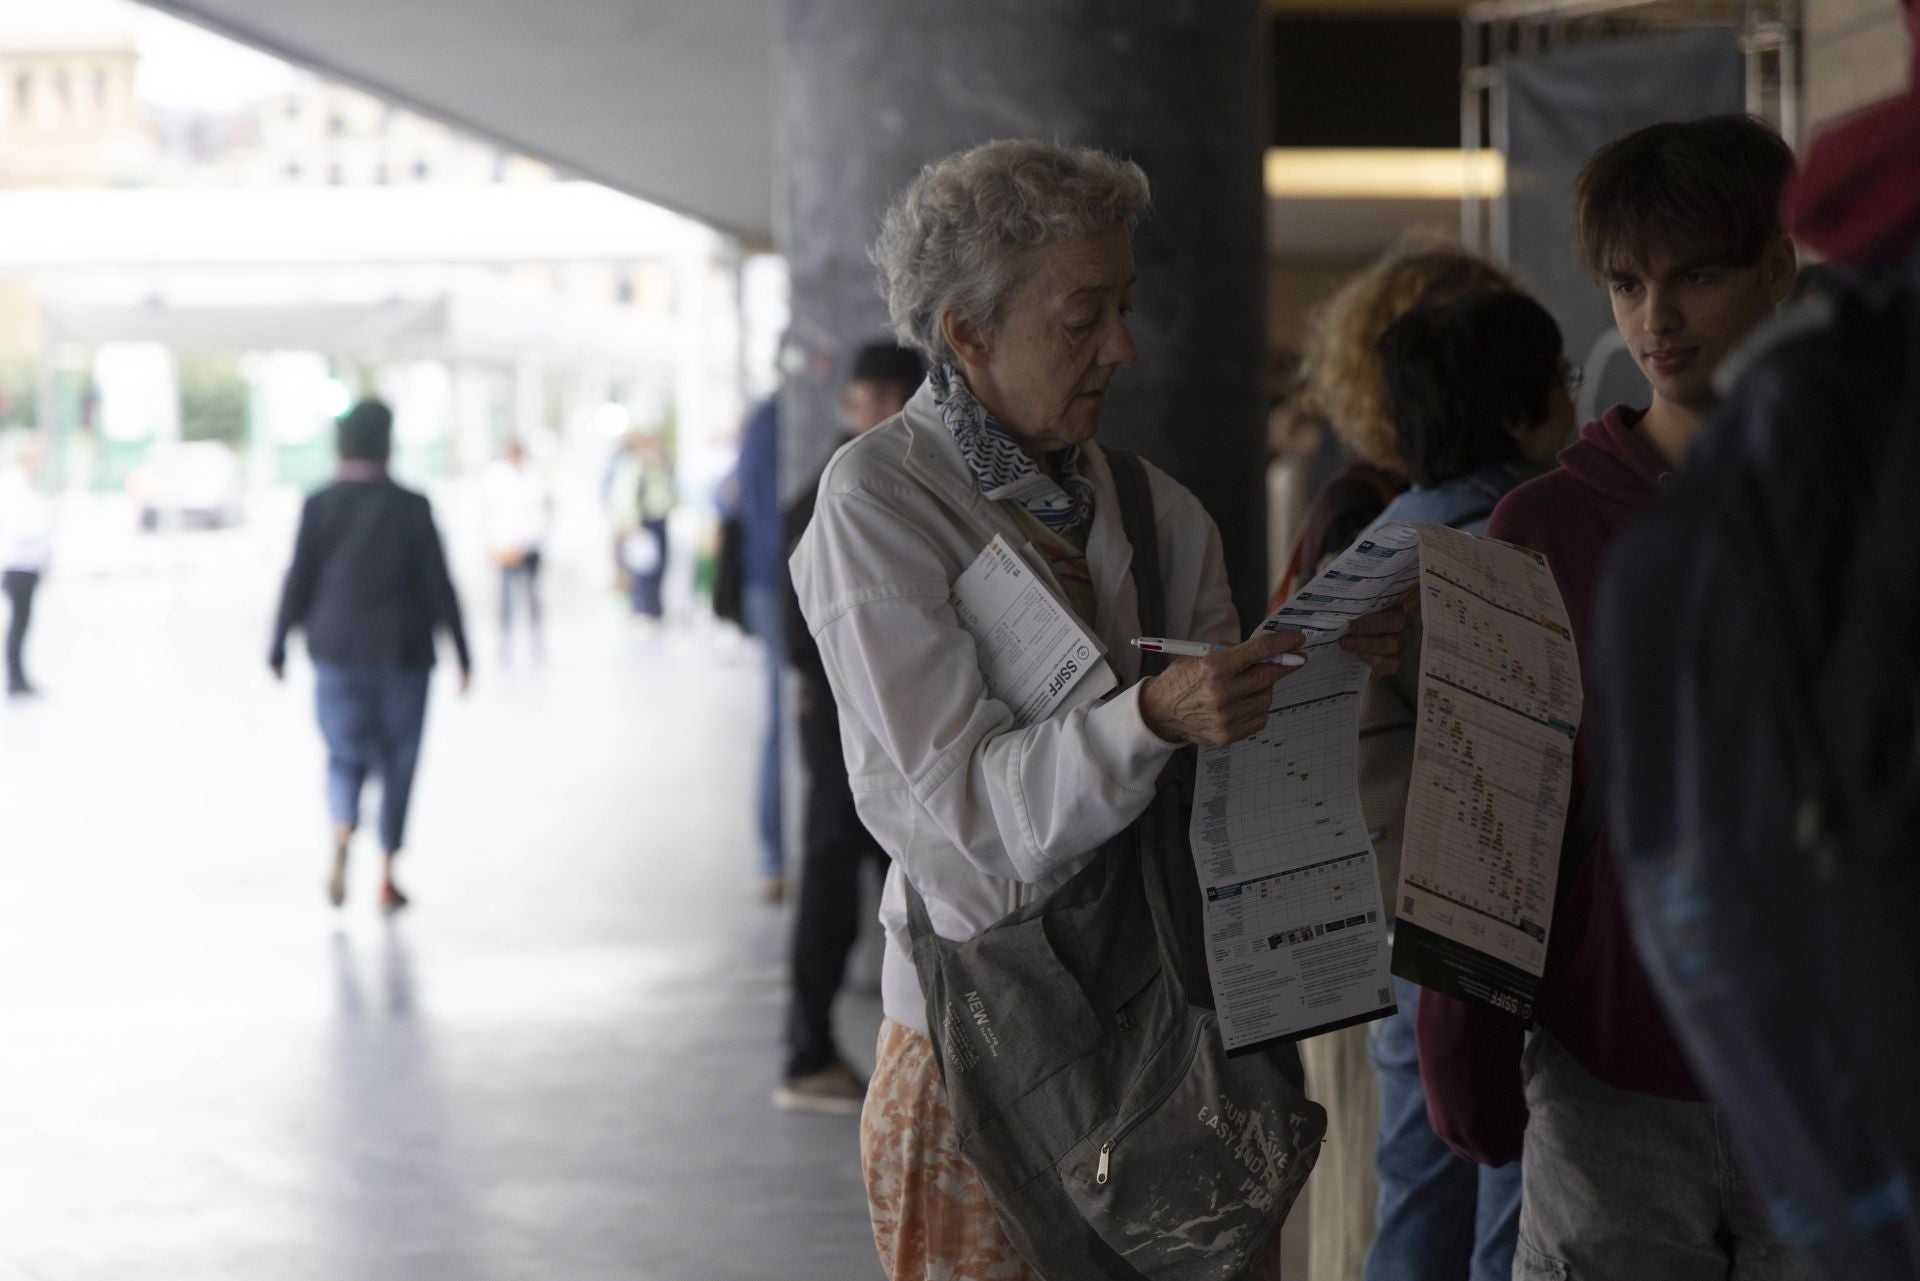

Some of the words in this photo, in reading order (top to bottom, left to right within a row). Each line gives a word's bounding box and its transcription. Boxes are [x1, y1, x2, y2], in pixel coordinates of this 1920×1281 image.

[1048, 660, 1077, 697] SSIFF
[964, 990, 990, 1026] NEW
[1490, 990, 1519, 1014] SSIFF
[1198, 1105, 1237, 1146] EASY
